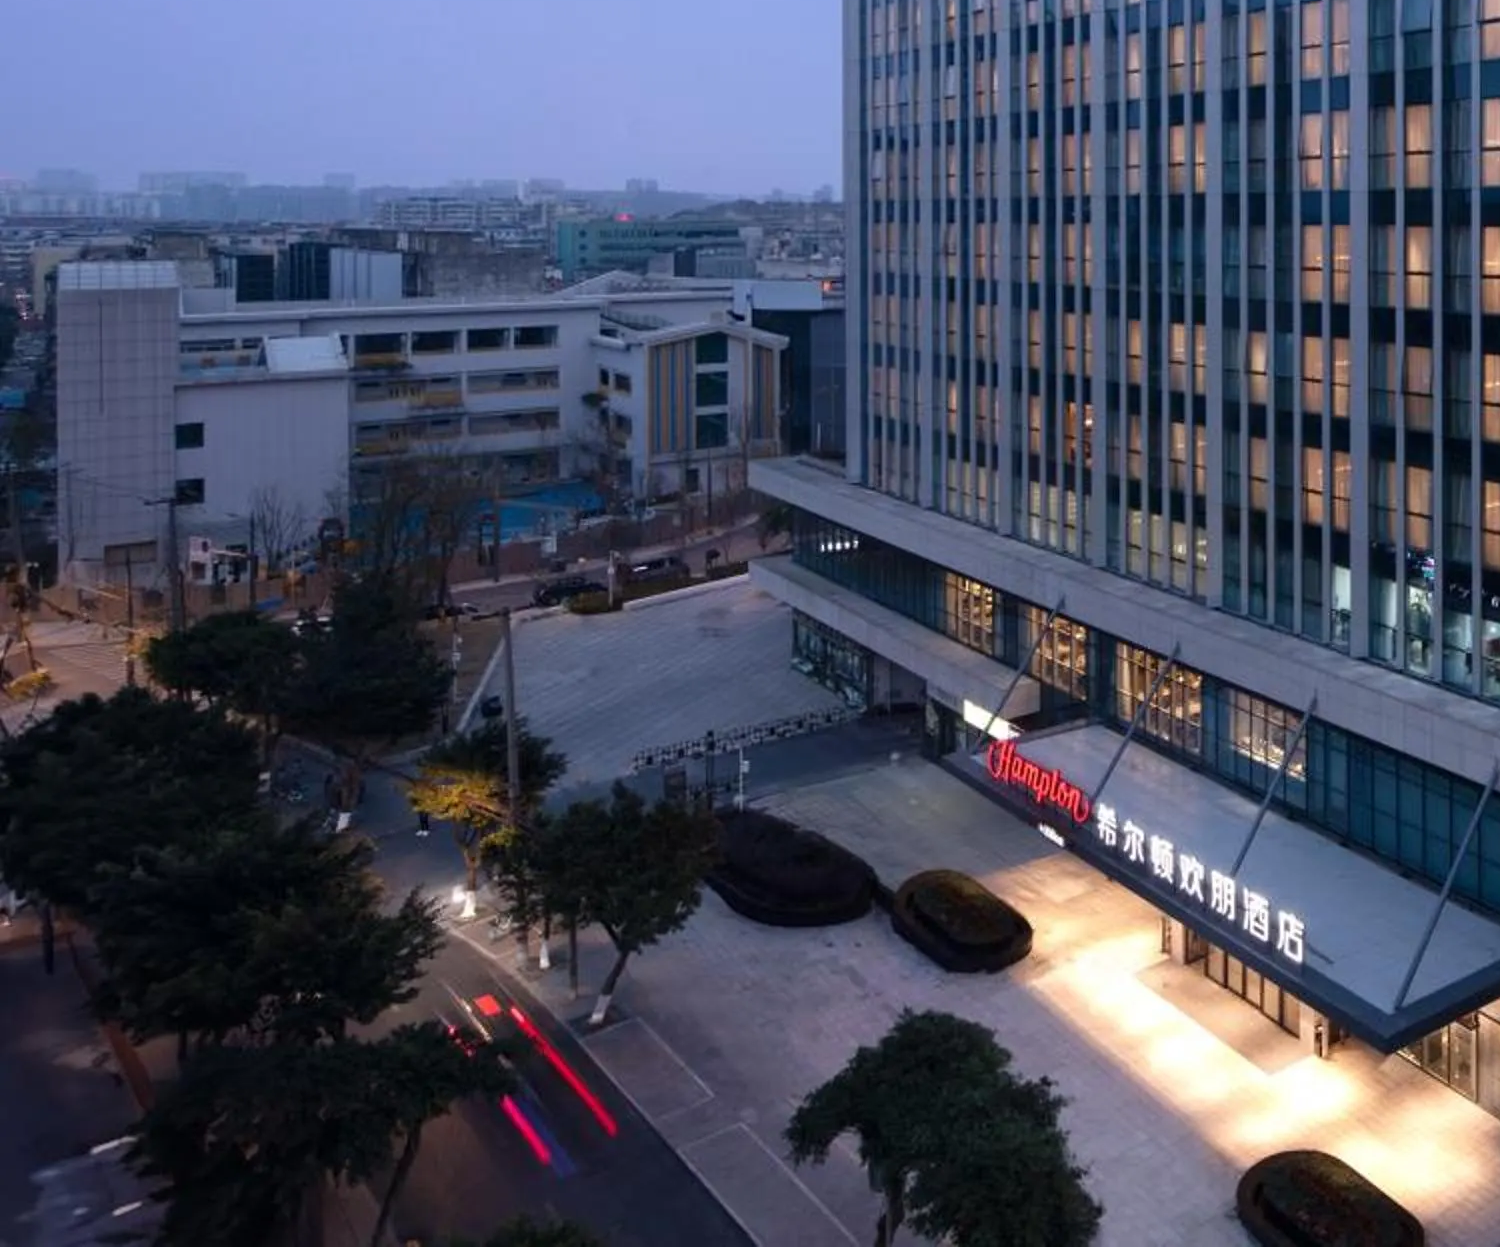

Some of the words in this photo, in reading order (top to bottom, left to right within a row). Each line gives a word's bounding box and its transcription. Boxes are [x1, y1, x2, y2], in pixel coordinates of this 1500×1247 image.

[986, 738, 1090, 824] Hampton
[1096, 802, 1305, 964] 希尔顿欢朋酒店
